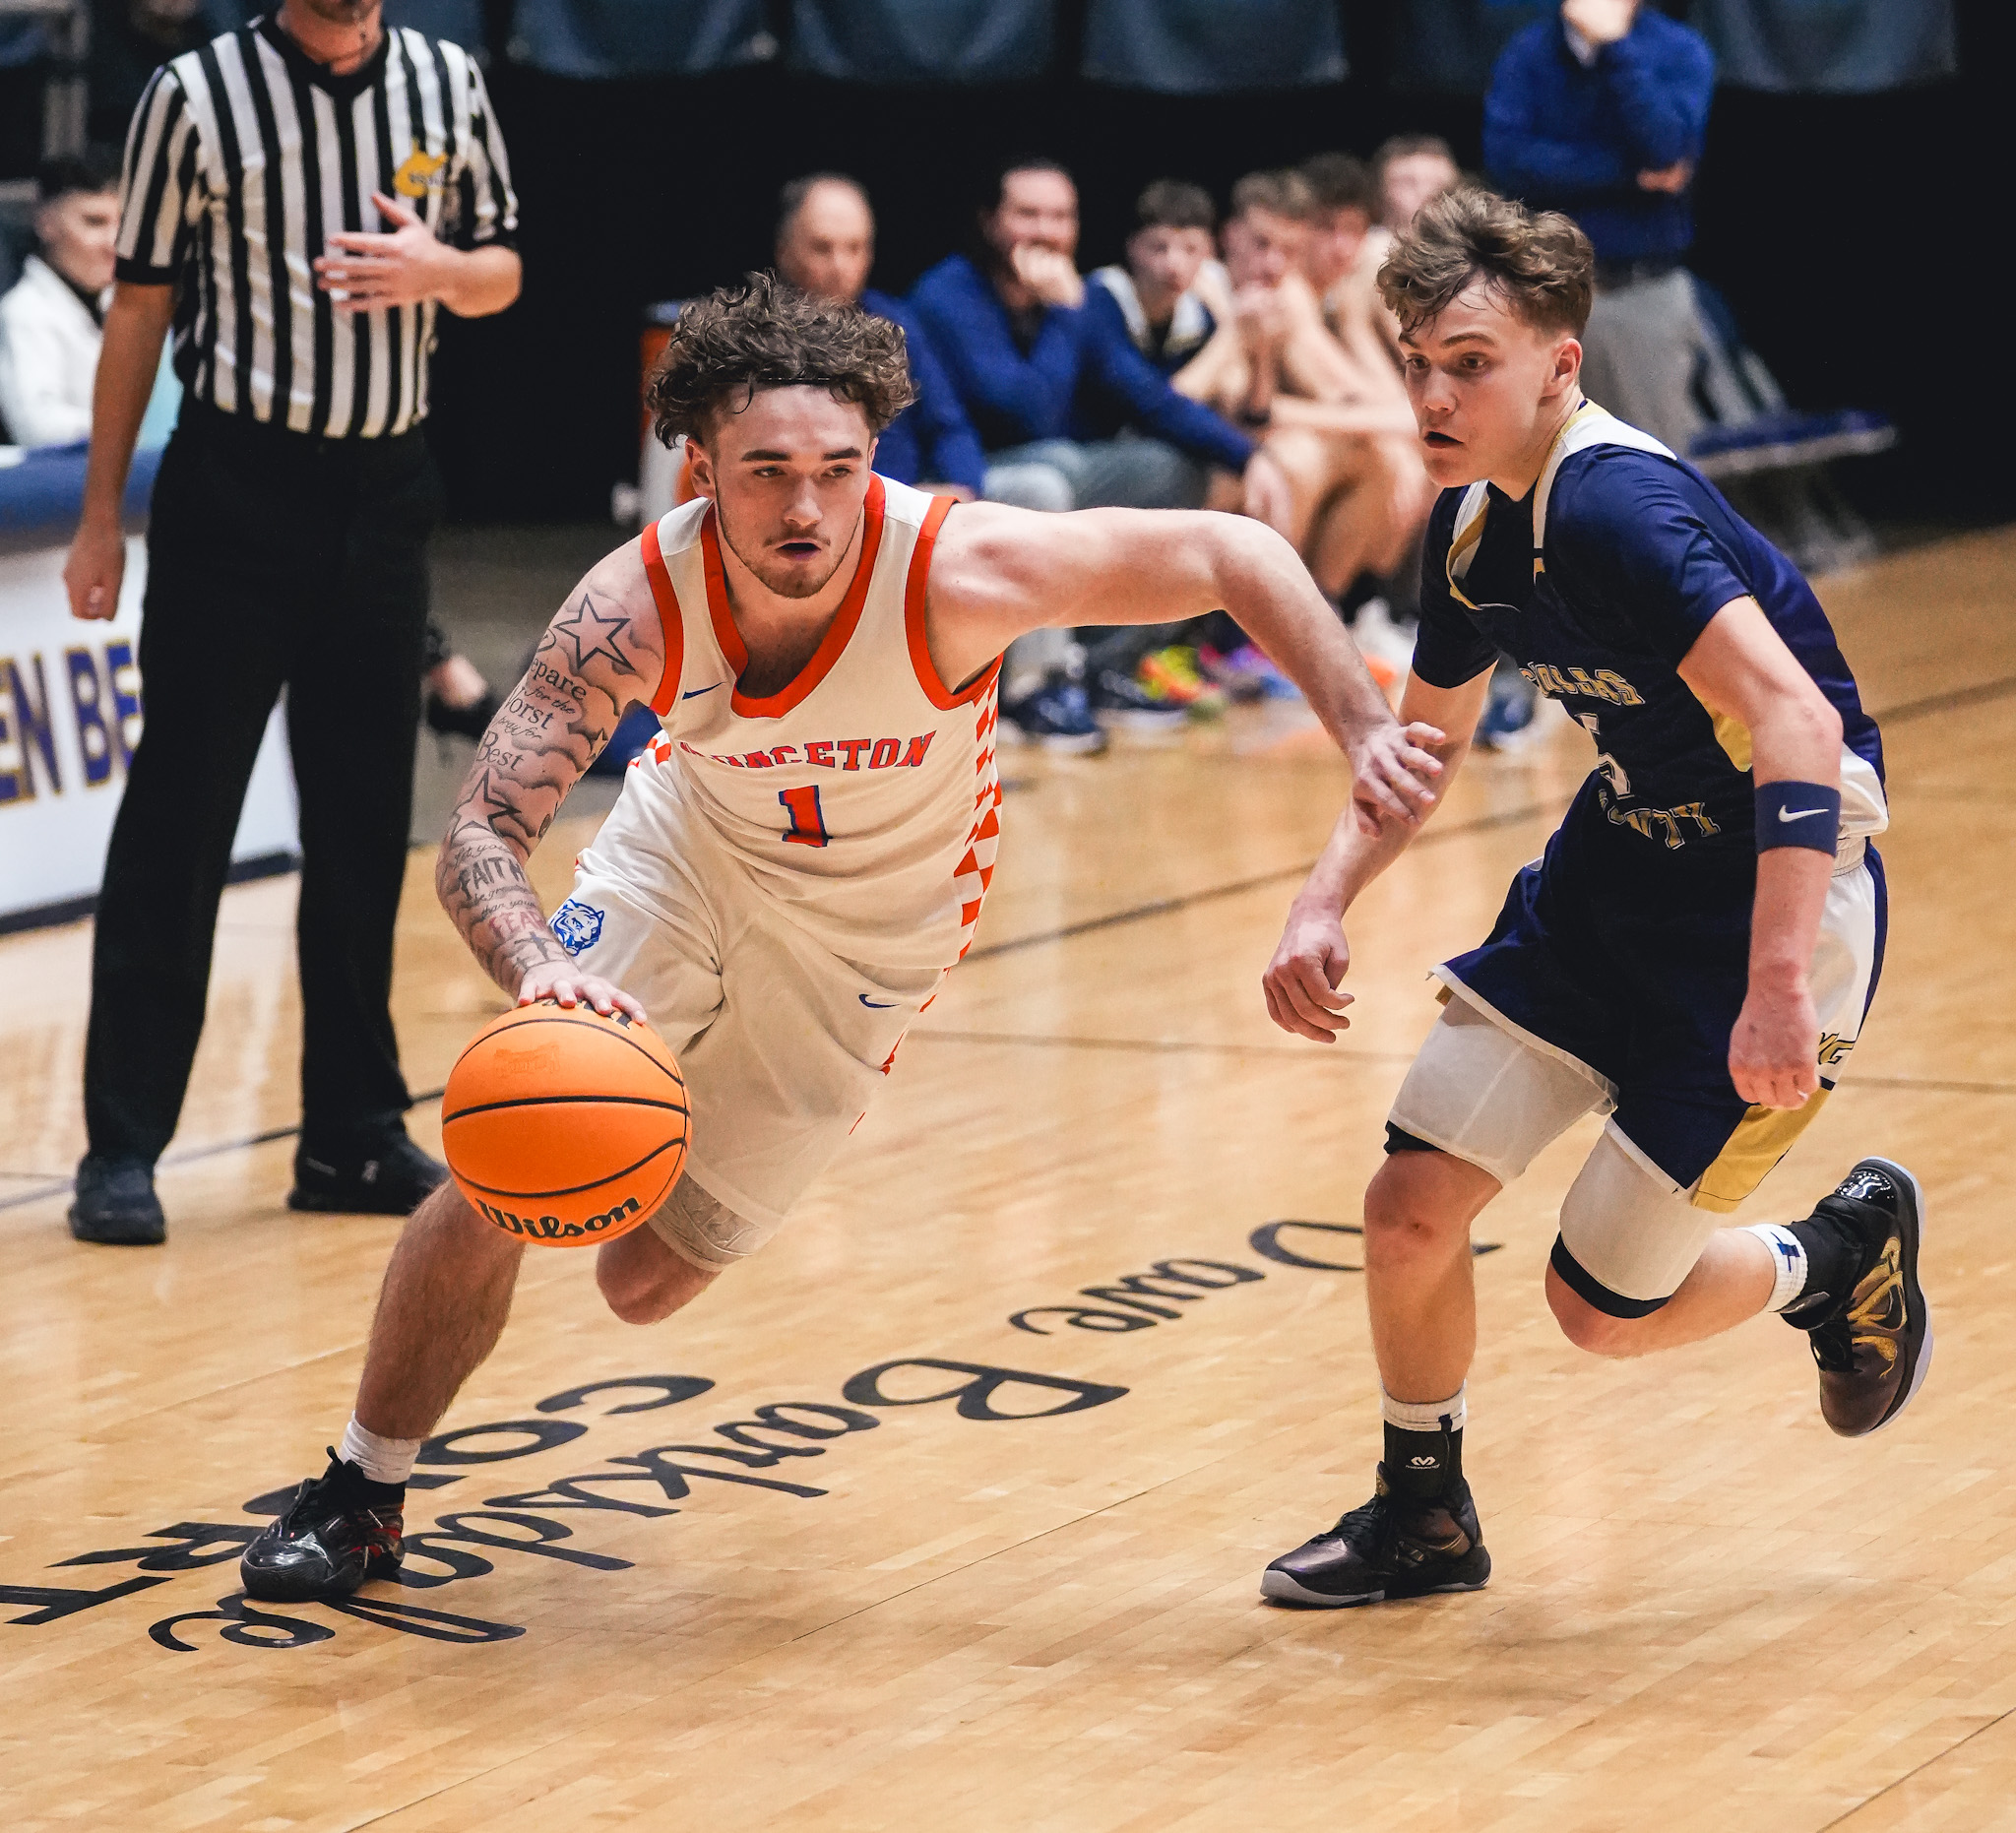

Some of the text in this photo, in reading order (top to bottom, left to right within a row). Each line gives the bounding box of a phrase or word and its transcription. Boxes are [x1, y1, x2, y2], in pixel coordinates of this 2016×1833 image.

[476, 729, 525, 772] Best
[679, 729, 937, 772] INCETON
[778, 785, 831, 848] 1
[458, 855, 527, 901] FAITH
[474, 1195, 642, 1239] Wilson
